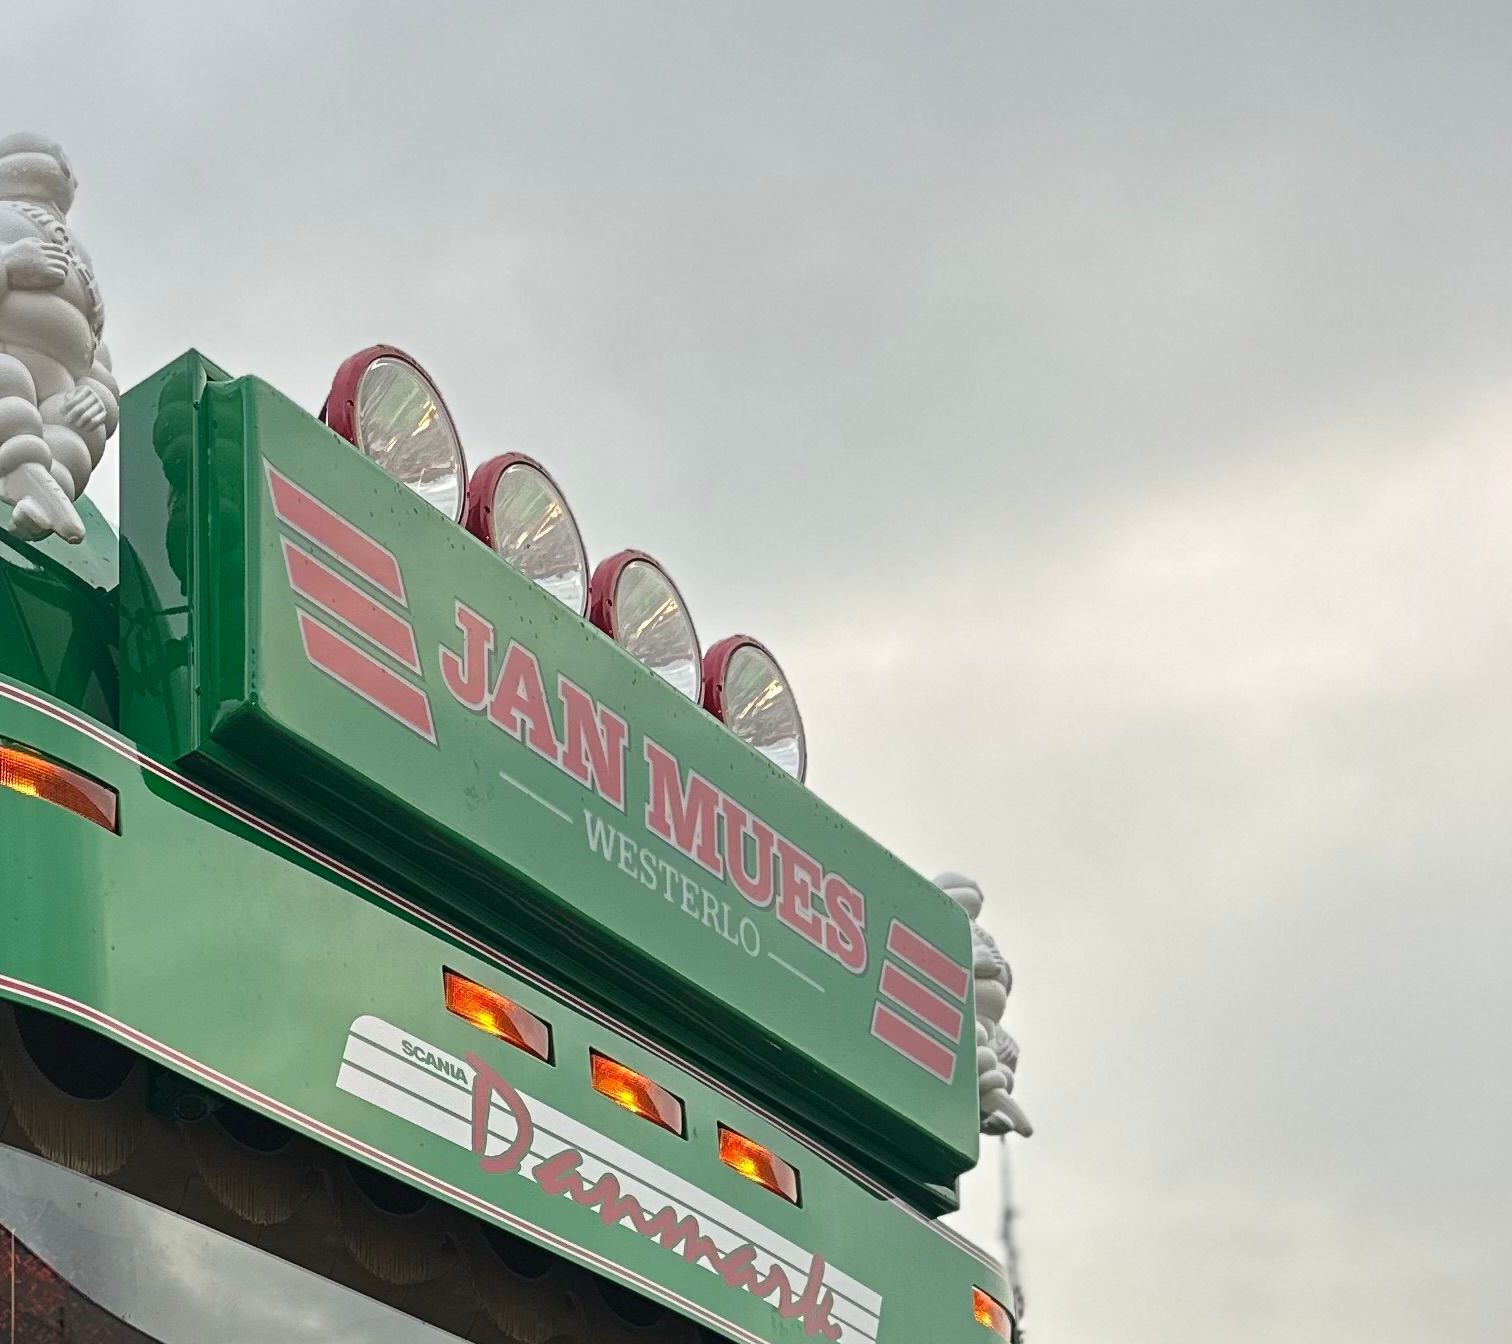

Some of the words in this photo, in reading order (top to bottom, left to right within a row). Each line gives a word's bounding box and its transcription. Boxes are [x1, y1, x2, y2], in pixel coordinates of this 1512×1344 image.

[439, 599, 631, 815] JAN
[643, 735, 868, 975] MUES
[583, 808, 761, 958] WESTERLO
[401, 1040, 468, 1085] SCANIA
[465, 1050, 843, 1342] Danmark
